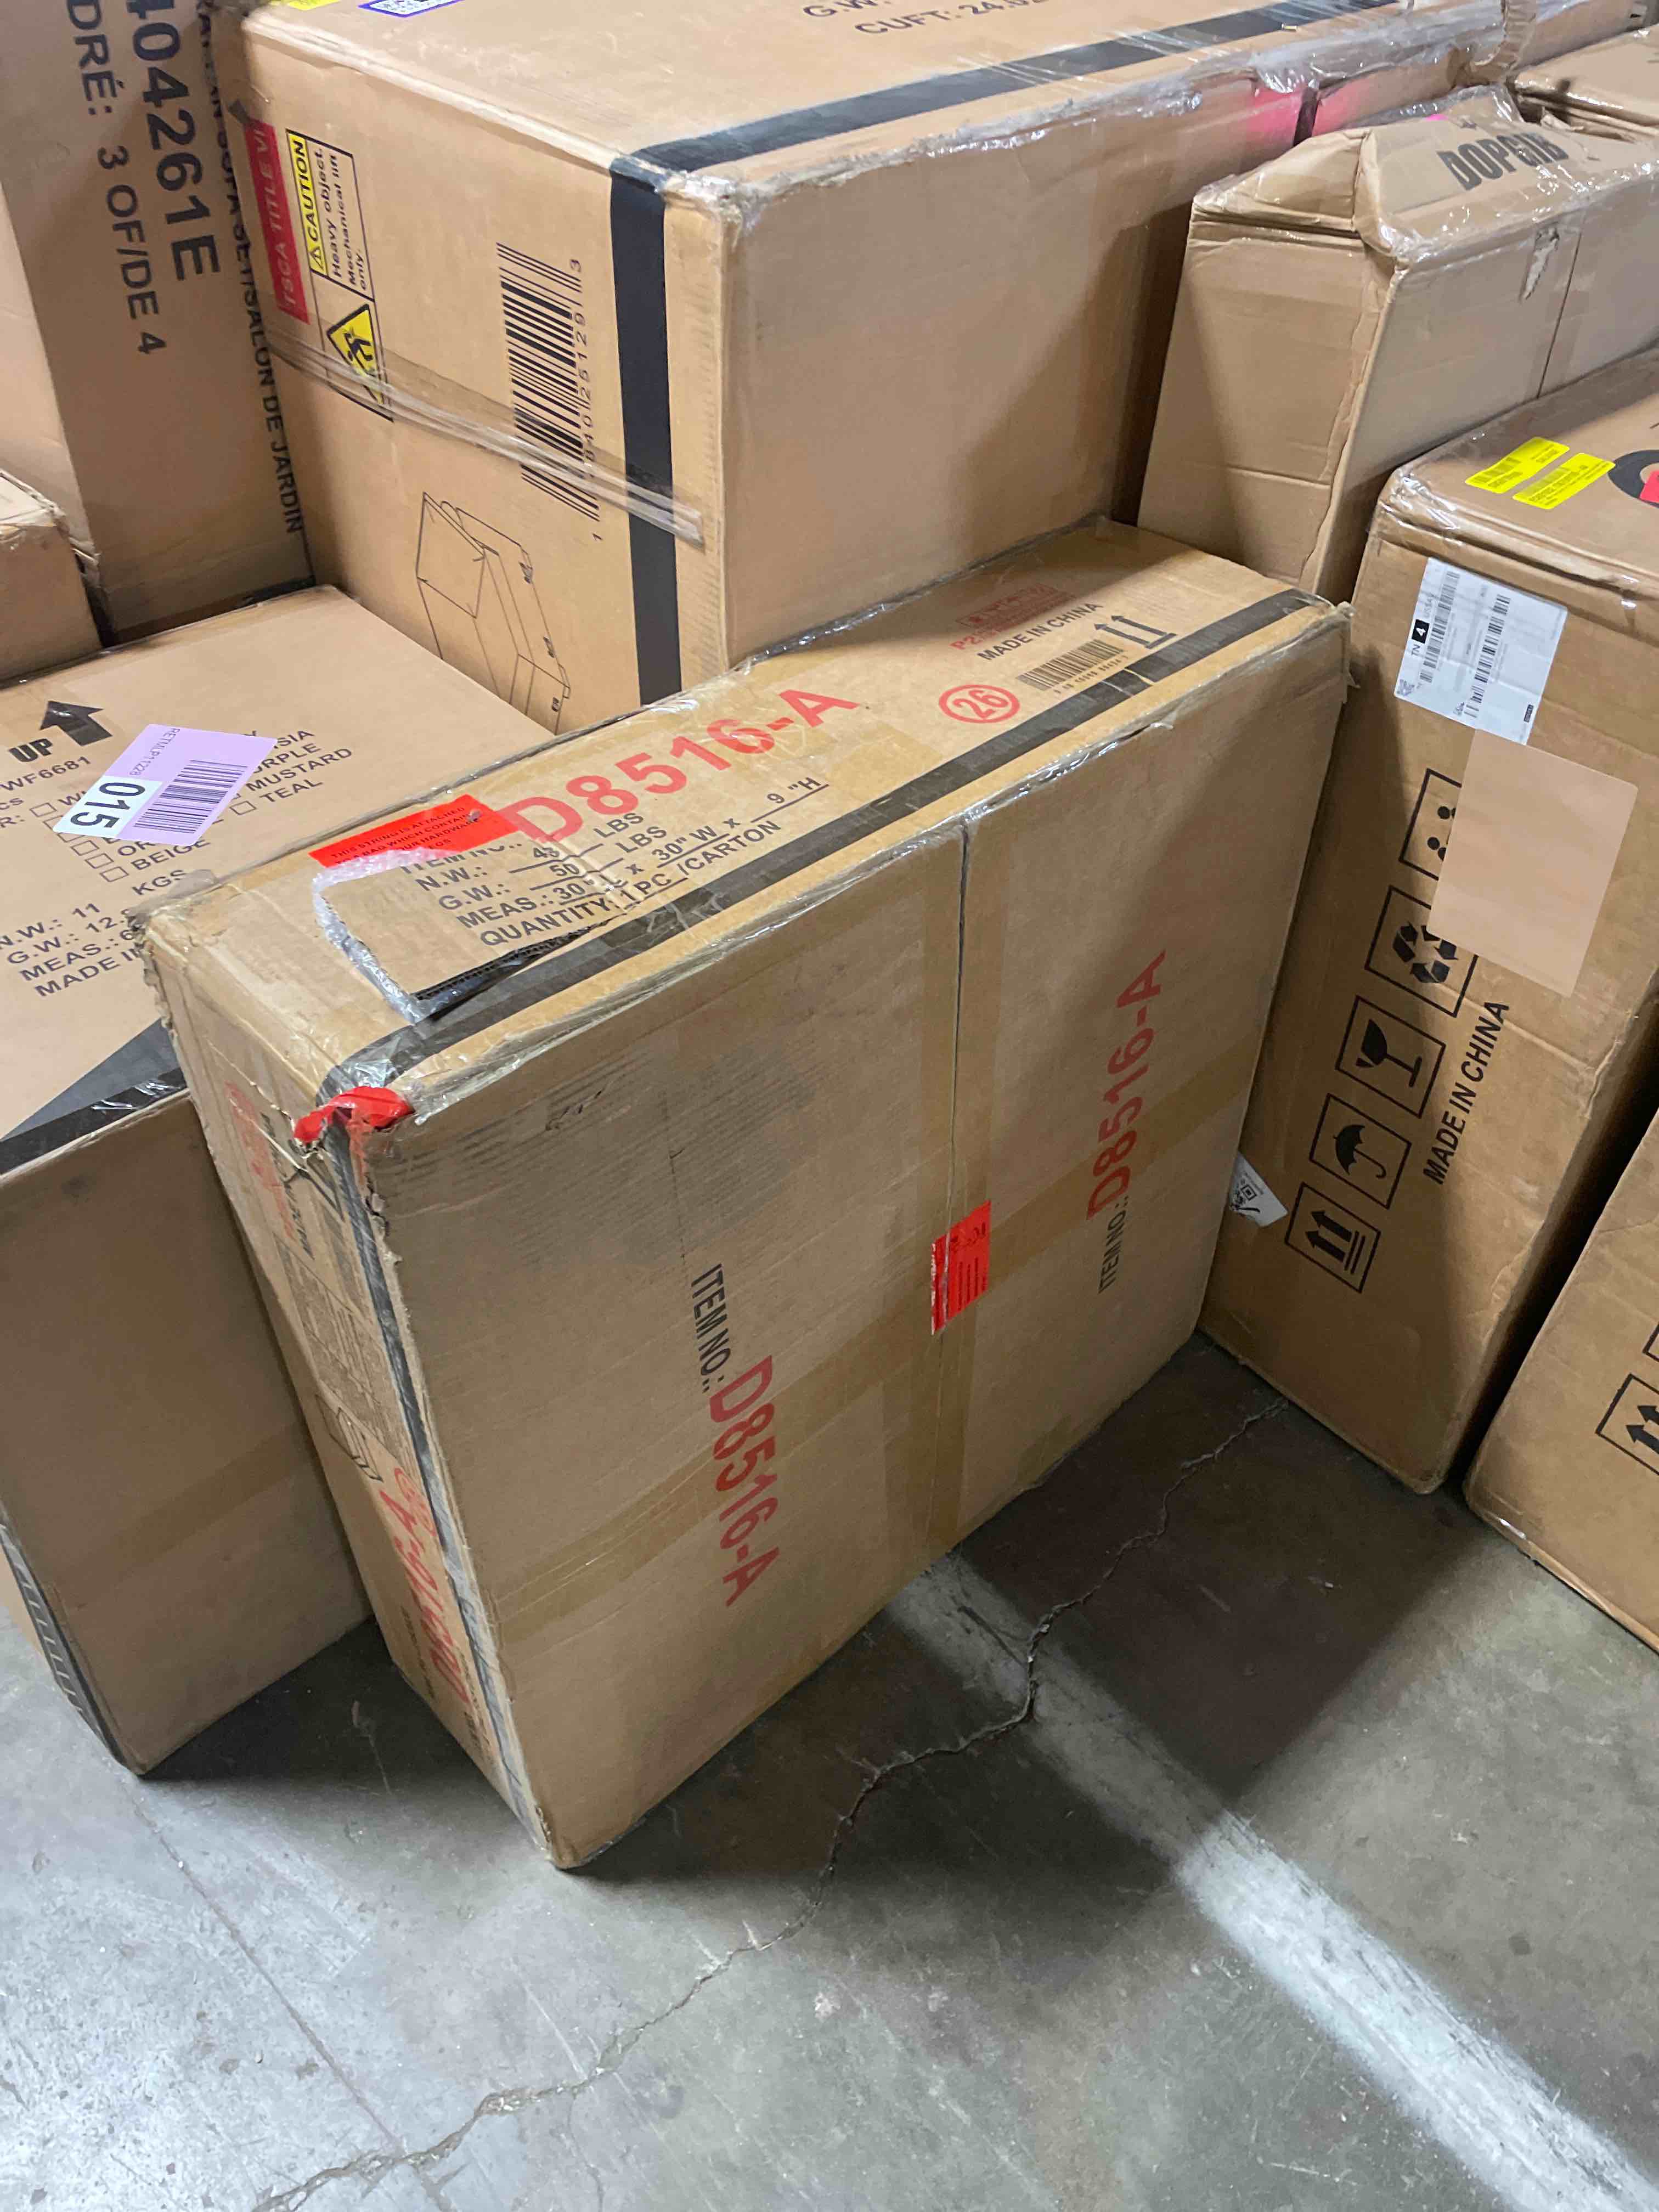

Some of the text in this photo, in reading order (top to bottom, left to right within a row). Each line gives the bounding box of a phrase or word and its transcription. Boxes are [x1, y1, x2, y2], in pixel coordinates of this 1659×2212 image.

[855, 10, 962, 35] CUFT:
[293, 139, 319, 242] CAUTION
[314, 148, 342, 278] Heavy object.
[97, 145, 167, 356] 3 OF/DE 4
[335, 183, 357, 286] Mechanical
[569, 258, 582, 273] 3
[262, 396, 284, 432] DE
[270, 440, 303, 534] JARDIN
[976, 632, 1034, 661] MADE
[1028, 624, 1052, 638] IN
[1046, 602, 1104, 629] CHINA
[1411, 644, 1421, 657] TN
[9, 738, 53, 763] UP
[274, 730, 315, 749] SIA
[245, 748, 353, 792] MUSTARD
[495, 689, 861, 843] D8516-A
[69, 781, 146, 829] 015
[258, 778, 324, 803] TEAL
[130, 839, 212, 871] BEIGE
[330, 849, 356, 859] THIS
[358, 832, 399, 849] STRING
[410, 806, 466, 830] ATTACHED
[383, 831, 423, 850] WHICH
[415, 865, 488, 891] N.W.:
[592, 812, 645, 839] LBS
[438, 825, 668, 911] G.W.: 50 LBS
[633, 872, 673, 896] PC
[71, 903, 100, 918] 11
[131, 869, 187, 896] KGS
[456, 894, 555, 929] MEAS.:
[7, 933, 80, 964] G.W.:
[19, 938, 119, 981] MEAS.:
[34, 956, 121, 997] MADE
[1086, 948, 1167, 1221] D8516-A
[1422, 1001, 1510, 1186] MADE IN CHINA
[1098, 1240, 1122, 1295] ITEM
[691, 1262, 727, 1340] ITEM
[709, 1355, 780, 1607] D8516-A
